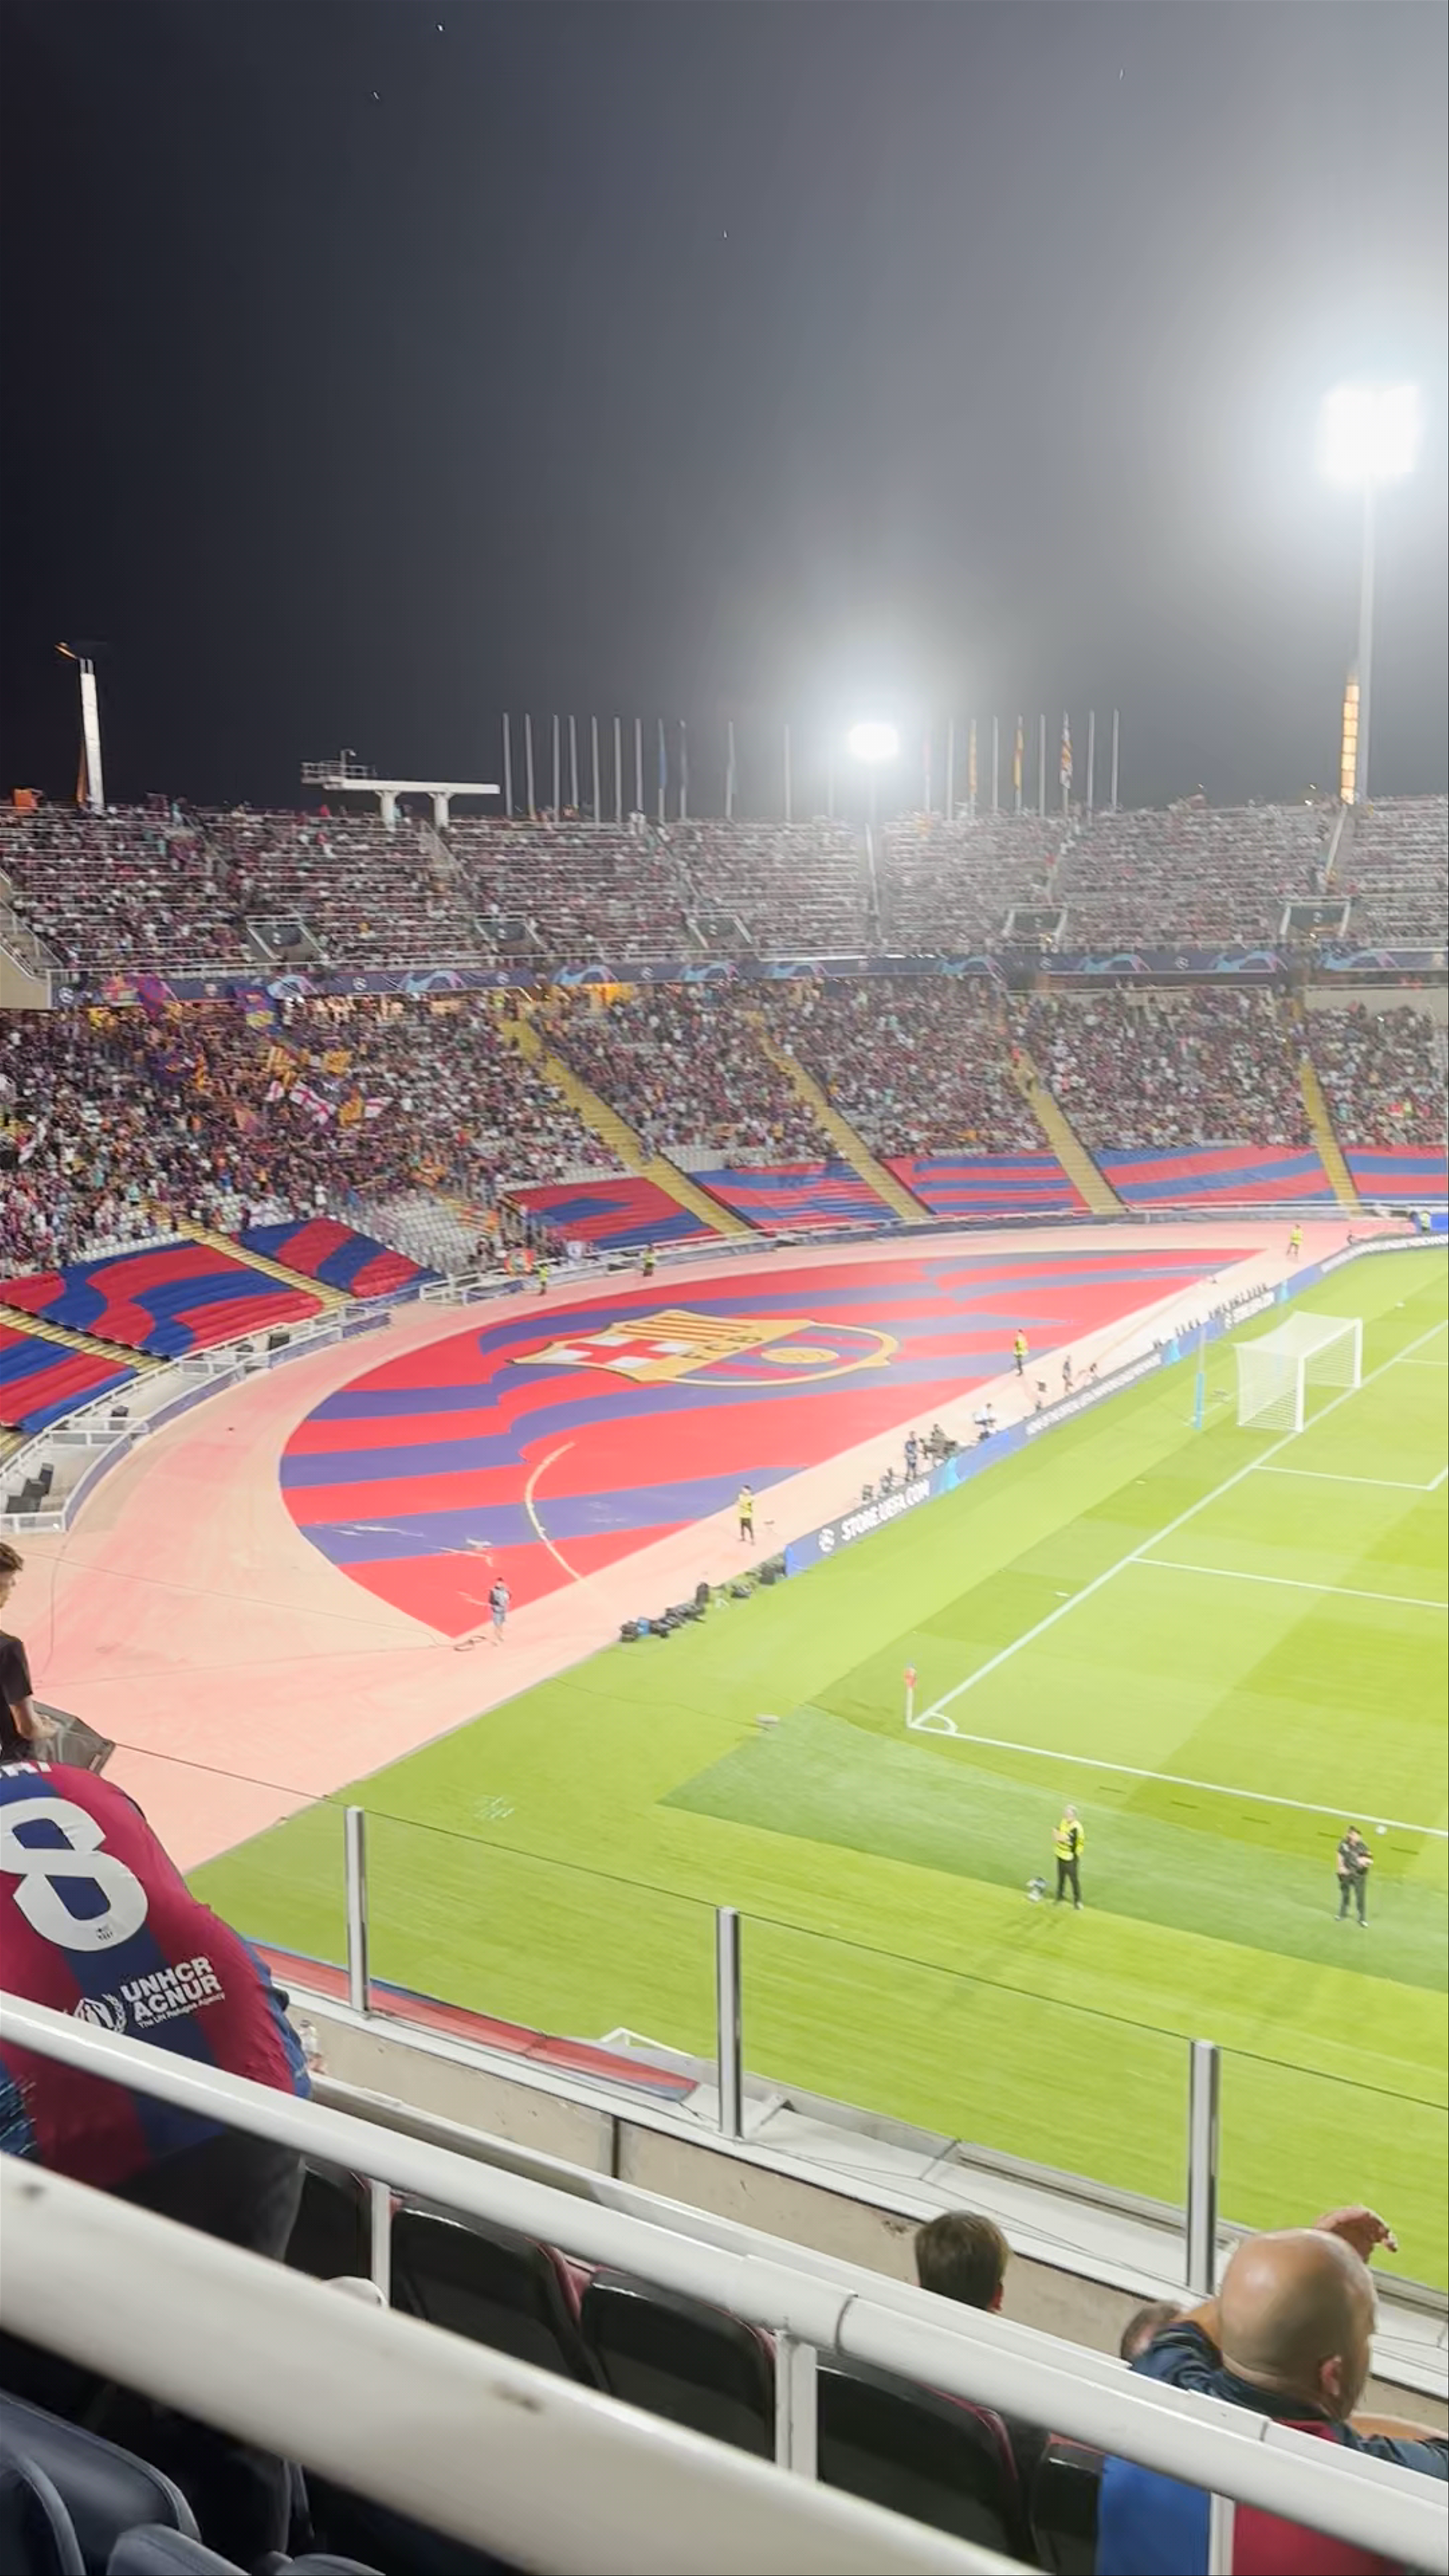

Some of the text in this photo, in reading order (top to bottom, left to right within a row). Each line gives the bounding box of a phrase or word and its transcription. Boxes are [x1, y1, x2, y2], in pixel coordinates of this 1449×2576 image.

[0, 1797, 149, 1952] 8
[120, 1956, 214, 2002] UNHCR
[134, 1974, 222, 2021] ACNUR
